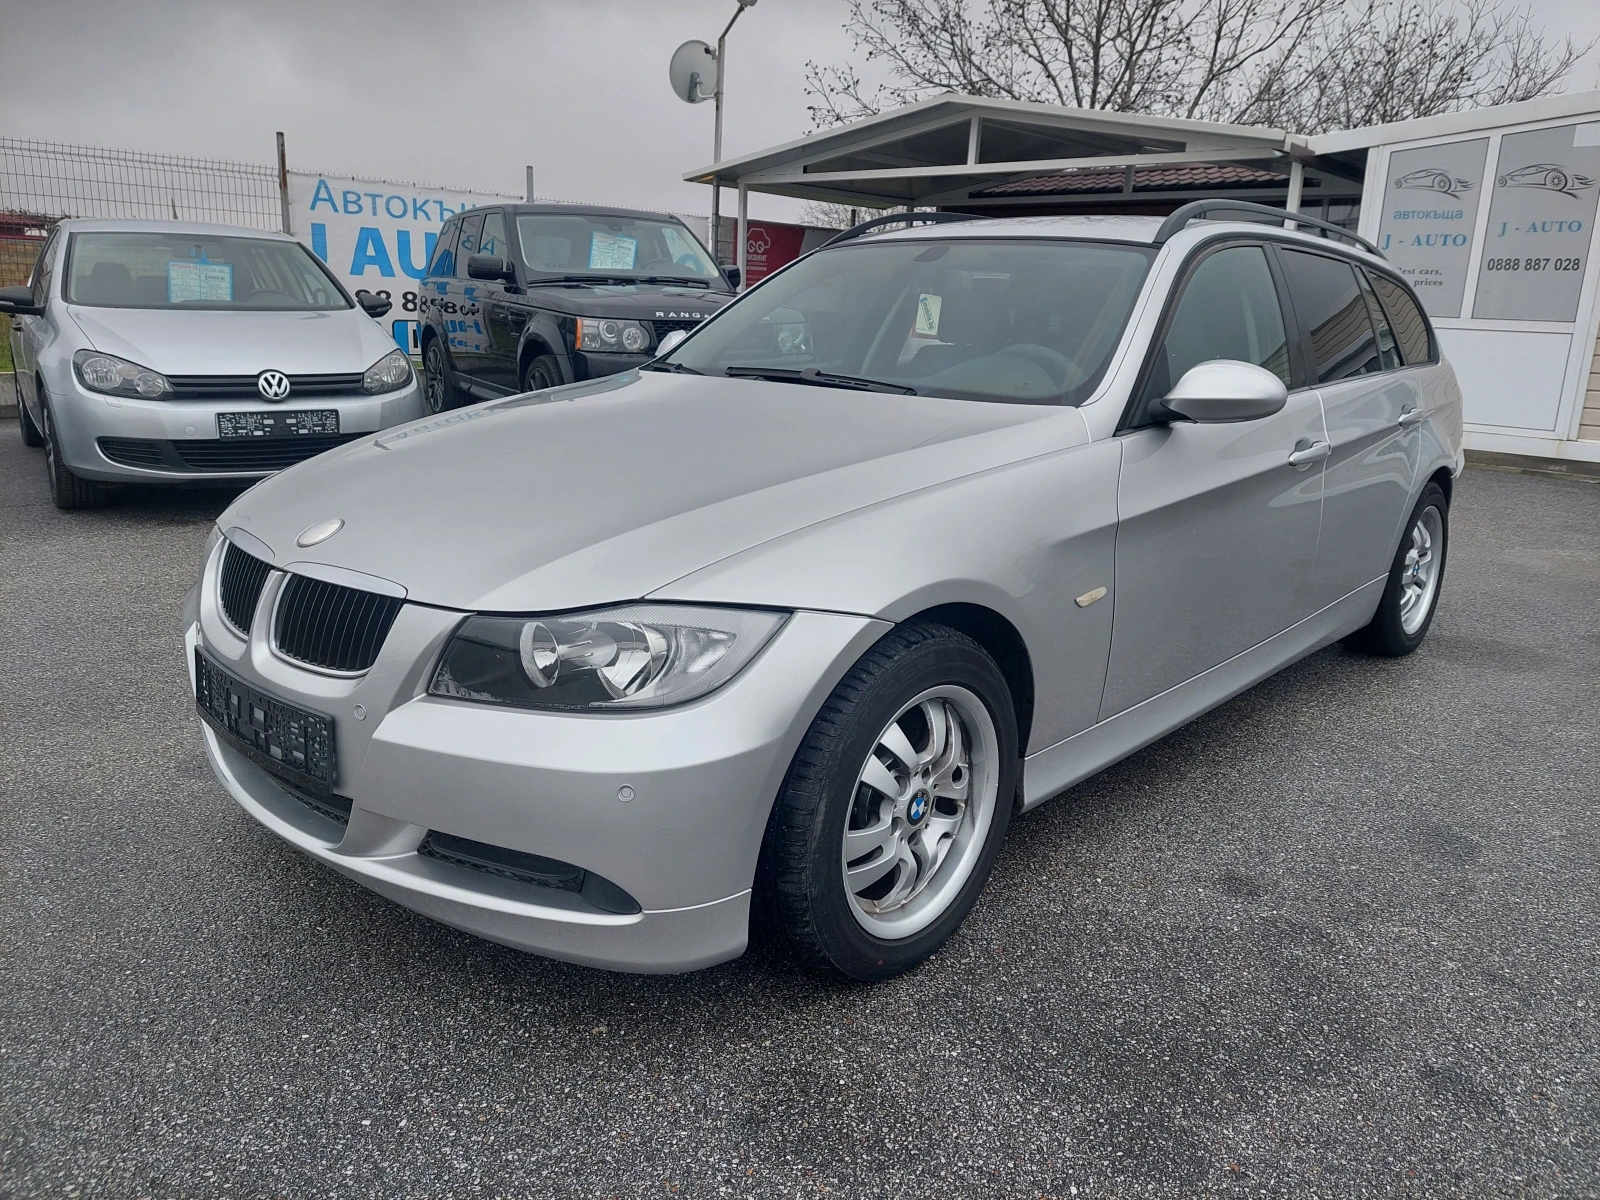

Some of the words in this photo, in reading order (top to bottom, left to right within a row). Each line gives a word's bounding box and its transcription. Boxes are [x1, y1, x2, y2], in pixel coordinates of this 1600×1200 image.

[1393, 208, 1464, 222] автокъща
[1498, 221, 1509, 238] J
[1526, 220, 1583, 233] AUTO
[1382, 233, 1392, 250] J
[1410, 233, 1468, 248] AUTO
[349, 226, 438, 281] AU
[1487, 257, 1521, 272] 0888
[1524, 257, 1550, 272] 887
[1554, 257, 1581, 272] 028
[1419, 268, 1443, 277] cars,
[1413, 278, 1443, 288] prices
